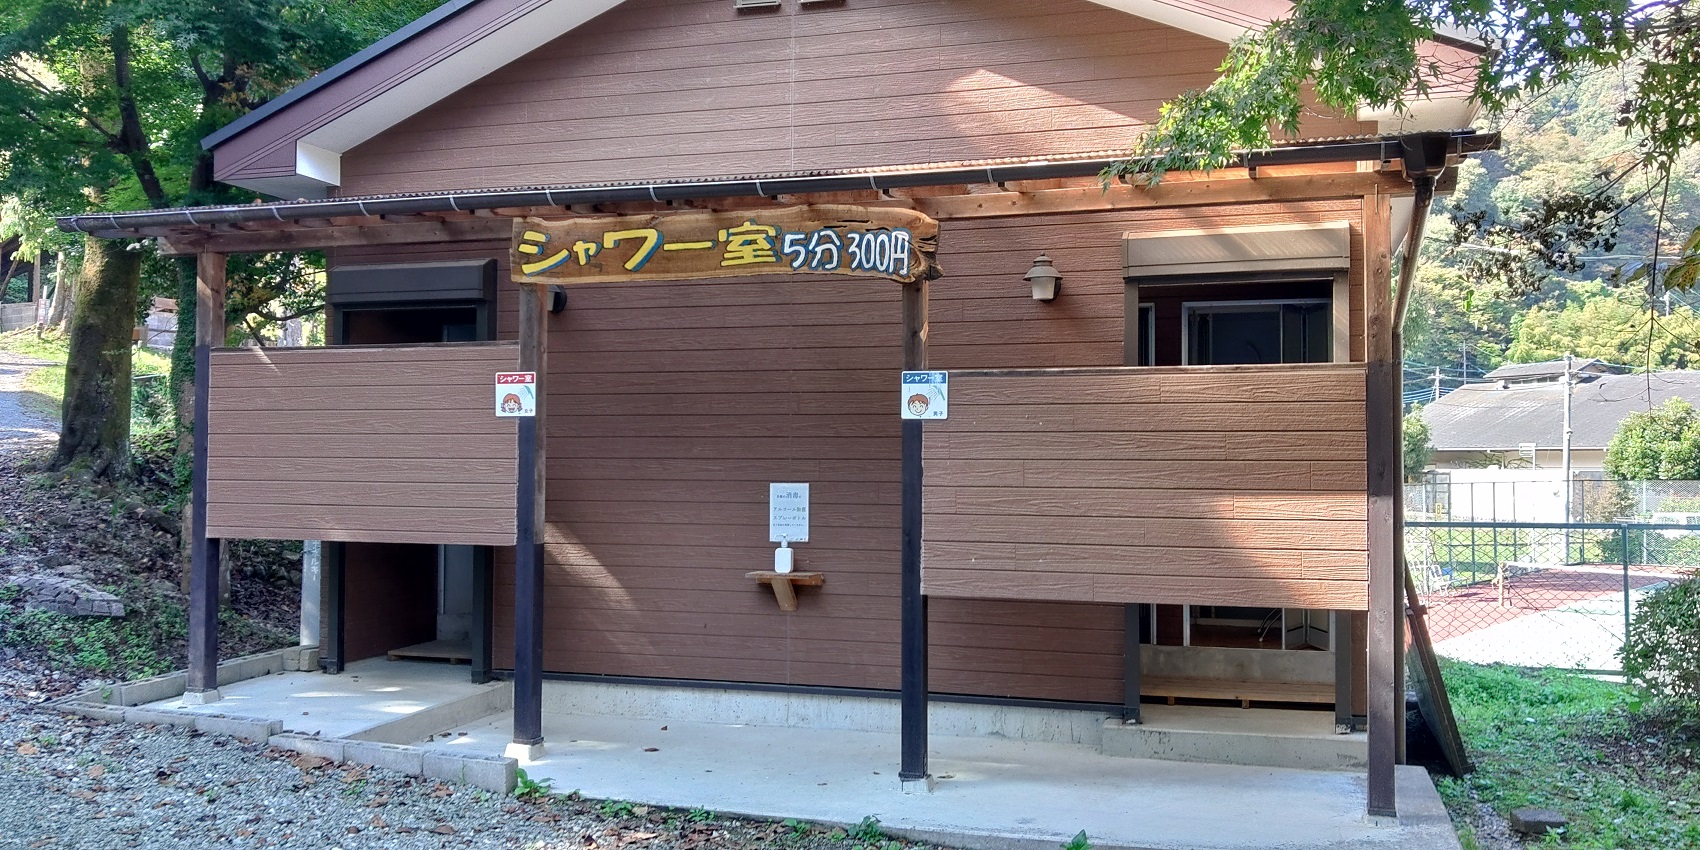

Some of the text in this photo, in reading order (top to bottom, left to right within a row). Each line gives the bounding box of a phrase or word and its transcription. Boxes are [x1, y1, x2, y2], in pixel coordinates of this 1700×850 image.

[518, 218, 912, 277] シャワー室 5分 300円
[499, 375, 532, 383] シャワー室
[905, 374, 943, 382] シャワー室
